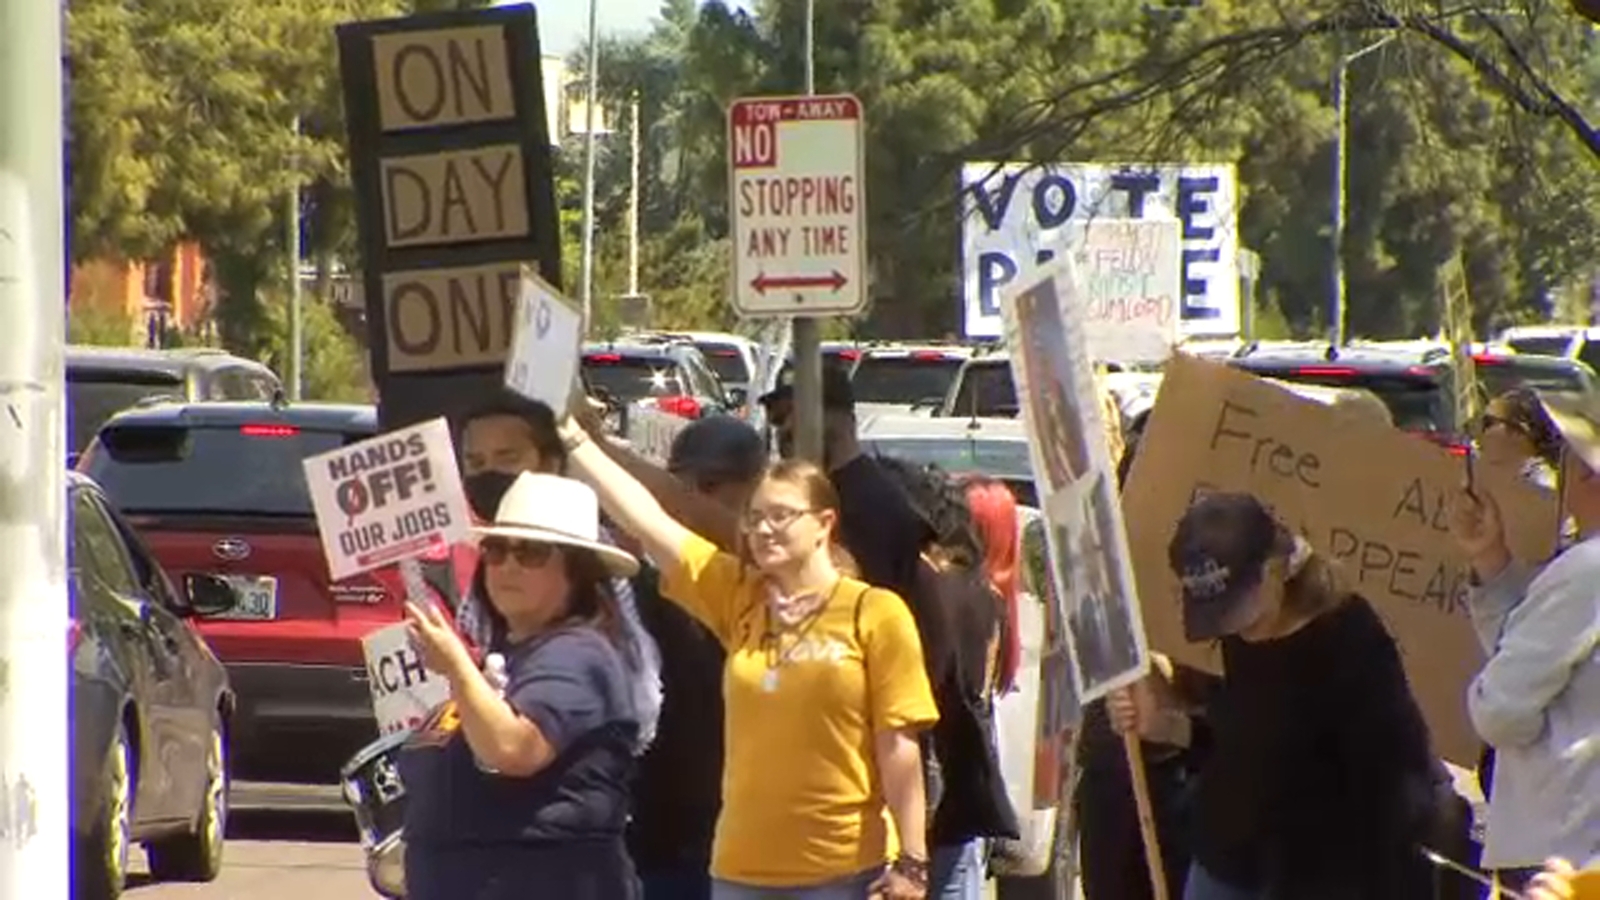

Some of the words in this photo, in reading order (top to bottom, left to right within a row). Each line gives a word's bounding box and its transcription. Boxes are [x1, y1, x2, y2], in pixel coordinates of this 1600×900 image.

[392, 37, 493, 122] ON
[746, 102, 846, 121] TOW-AWAY
[735, 124, 772, 164] NO
[386, 152, 514, 242] DAY
[740, 175, 855, 218] STOPPING
[971, 166, 1219, 240] VOTE
[747, 227, 791, 258] ANY
[801, 225, 850, 257] TIME
[328, 433, 427, 481] HANDS
[1210, 399, 1321, 489] Free
[1392, 477, 1450, 533] AL
[338, 522, 386, 556] OUR
[392, 502, 452, 541] JOBS
